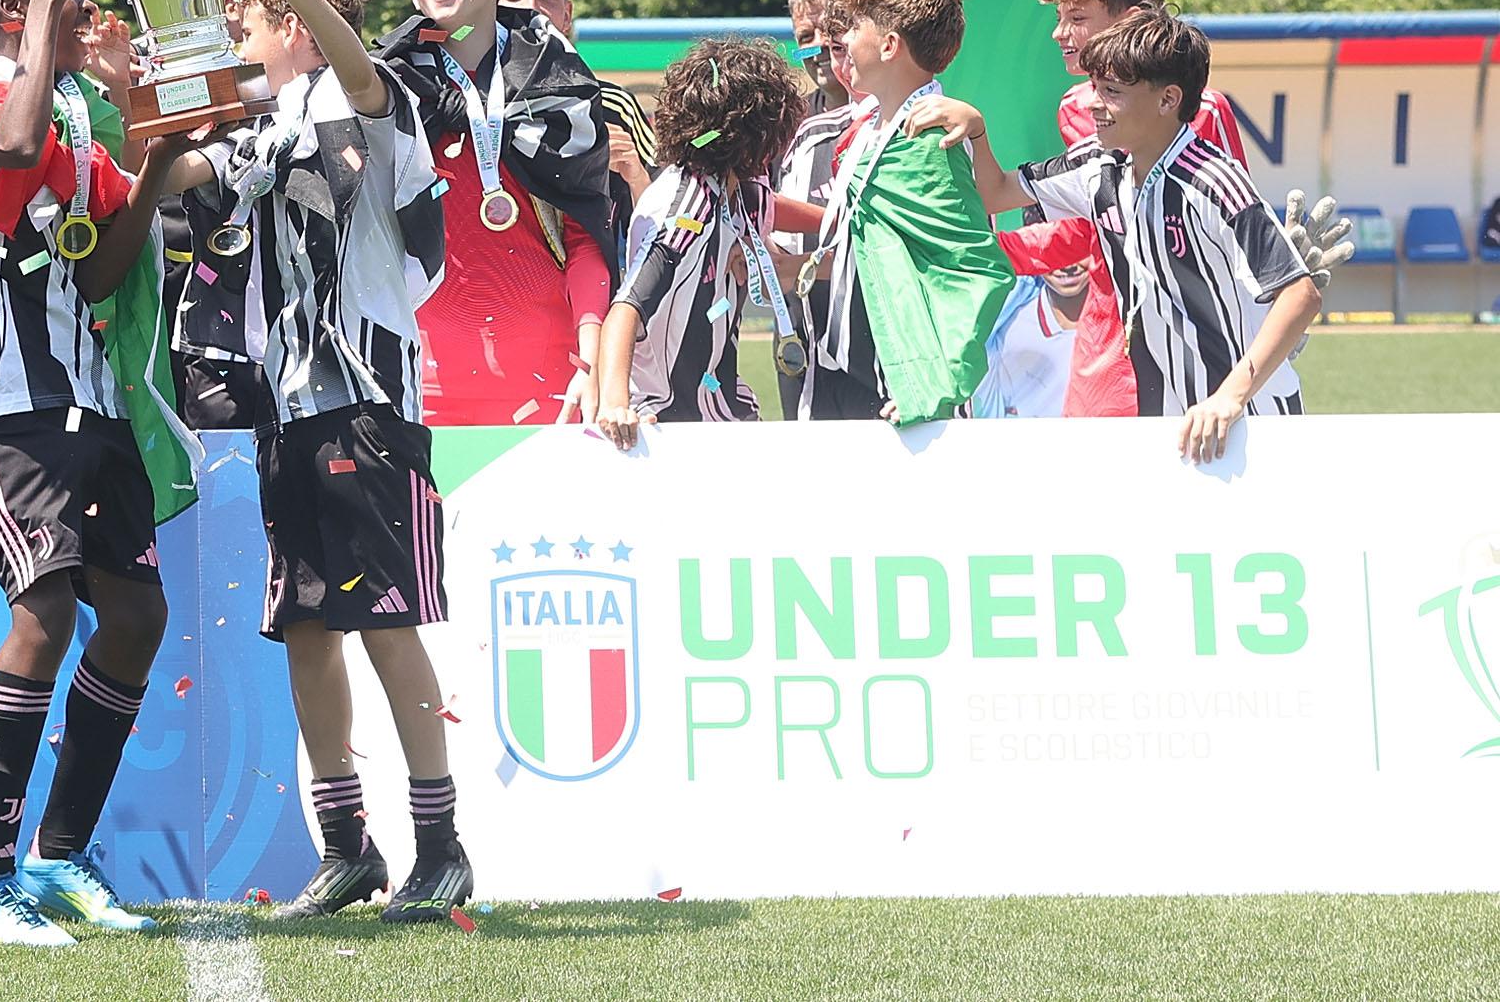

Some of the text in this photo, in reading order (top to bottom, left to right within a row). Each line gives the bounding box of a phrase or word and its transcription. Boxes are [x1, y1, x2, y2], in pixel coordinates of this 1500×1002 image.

[1395, 93, 1409, 165] I
[503, 590, 624, 626] ITALIA
[678, 552, 1309, 660] UNDER 13
[685, 674, 934, 782] PRO
[967, 690, 1315, 723] SETTORE GIOVANILE
[969, 732, 1213, 762] E SCOLASTICO
